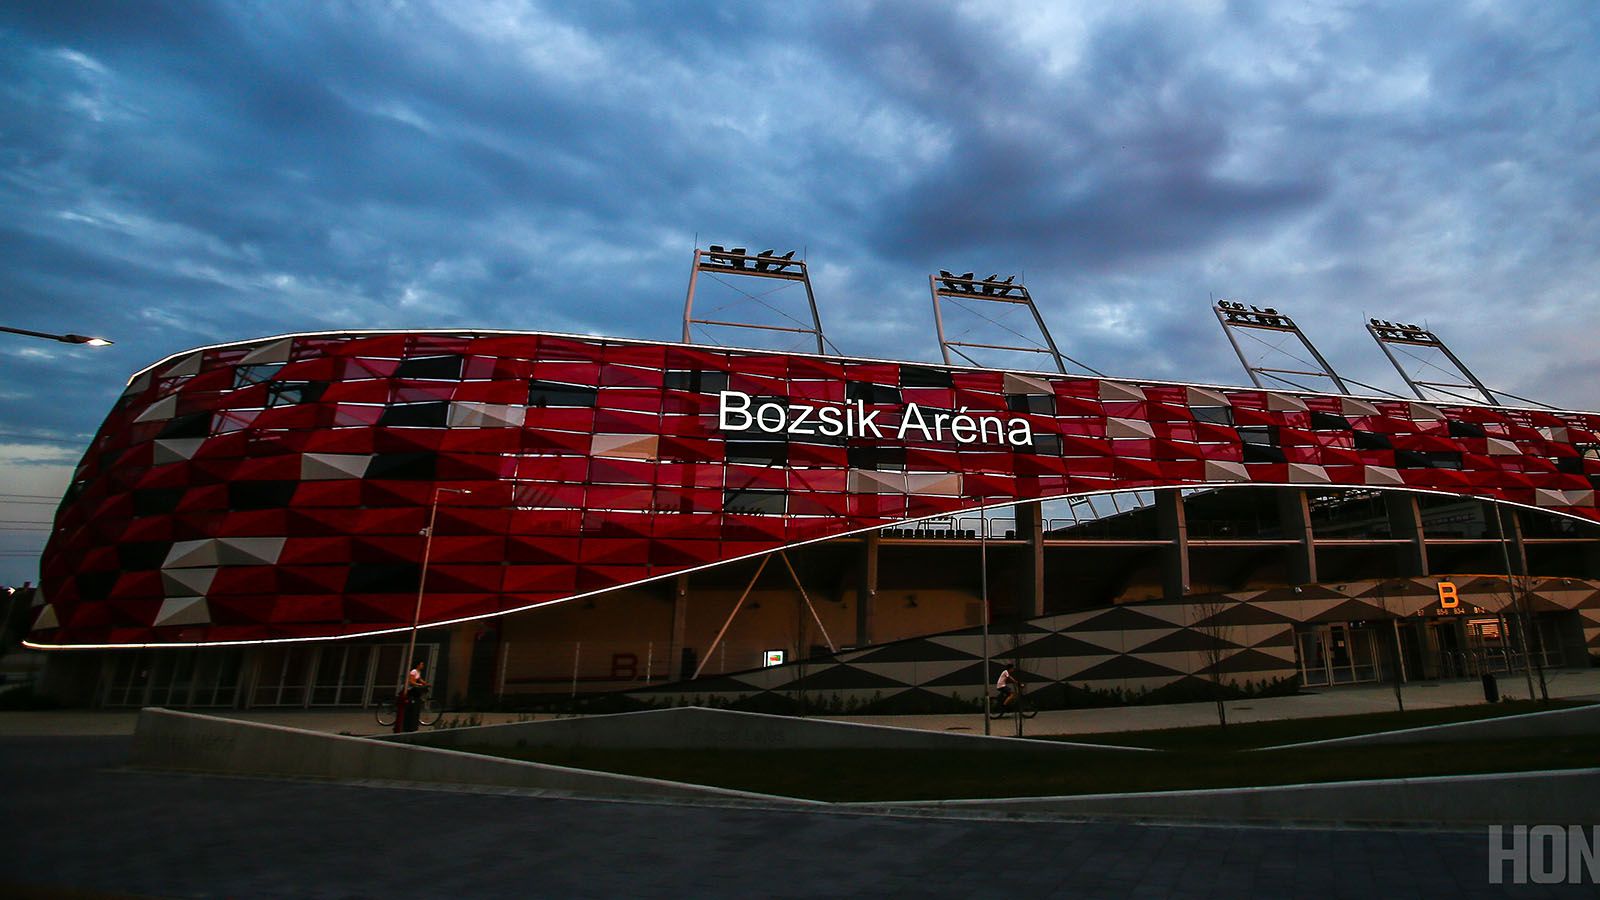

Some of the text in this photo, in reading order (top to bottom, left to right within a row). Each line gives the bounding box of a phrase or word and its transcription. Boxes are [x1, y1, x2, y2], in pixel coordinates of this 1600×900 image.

[718, 390, 1034, 447] Bozsik Aréna
[1437, 582, 1459, 609] B
[612, 653, 638, 681] B
